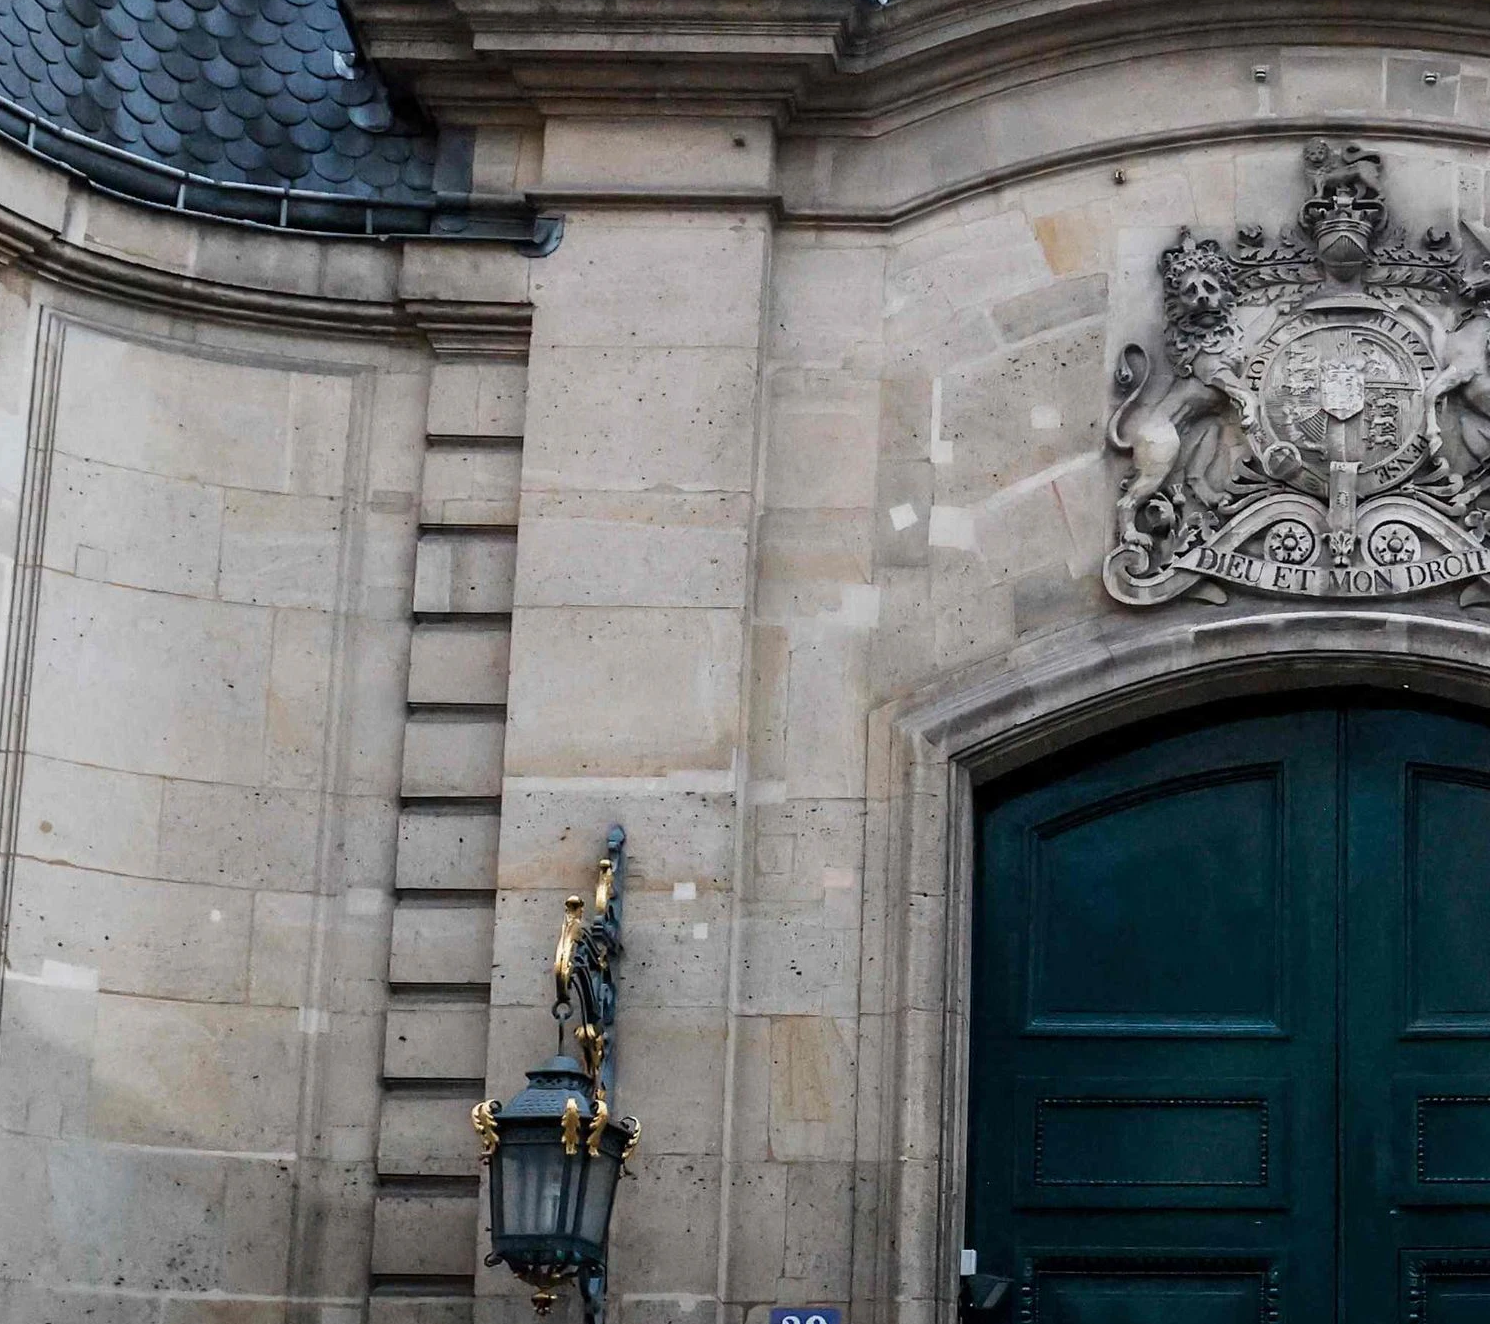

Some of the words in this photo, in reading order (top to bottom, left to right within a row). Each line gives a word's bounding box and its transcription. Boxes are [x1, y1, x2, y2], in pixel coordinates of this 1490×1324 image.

[1374, 434, 1430, 484] PENSE
[1196, 546, 1266, 583] DIEU
[1272, 565, 1316, 590] ET
[1328, 568, 1394, 593] MON
[1405, 548, 1489, 587] DROIT
